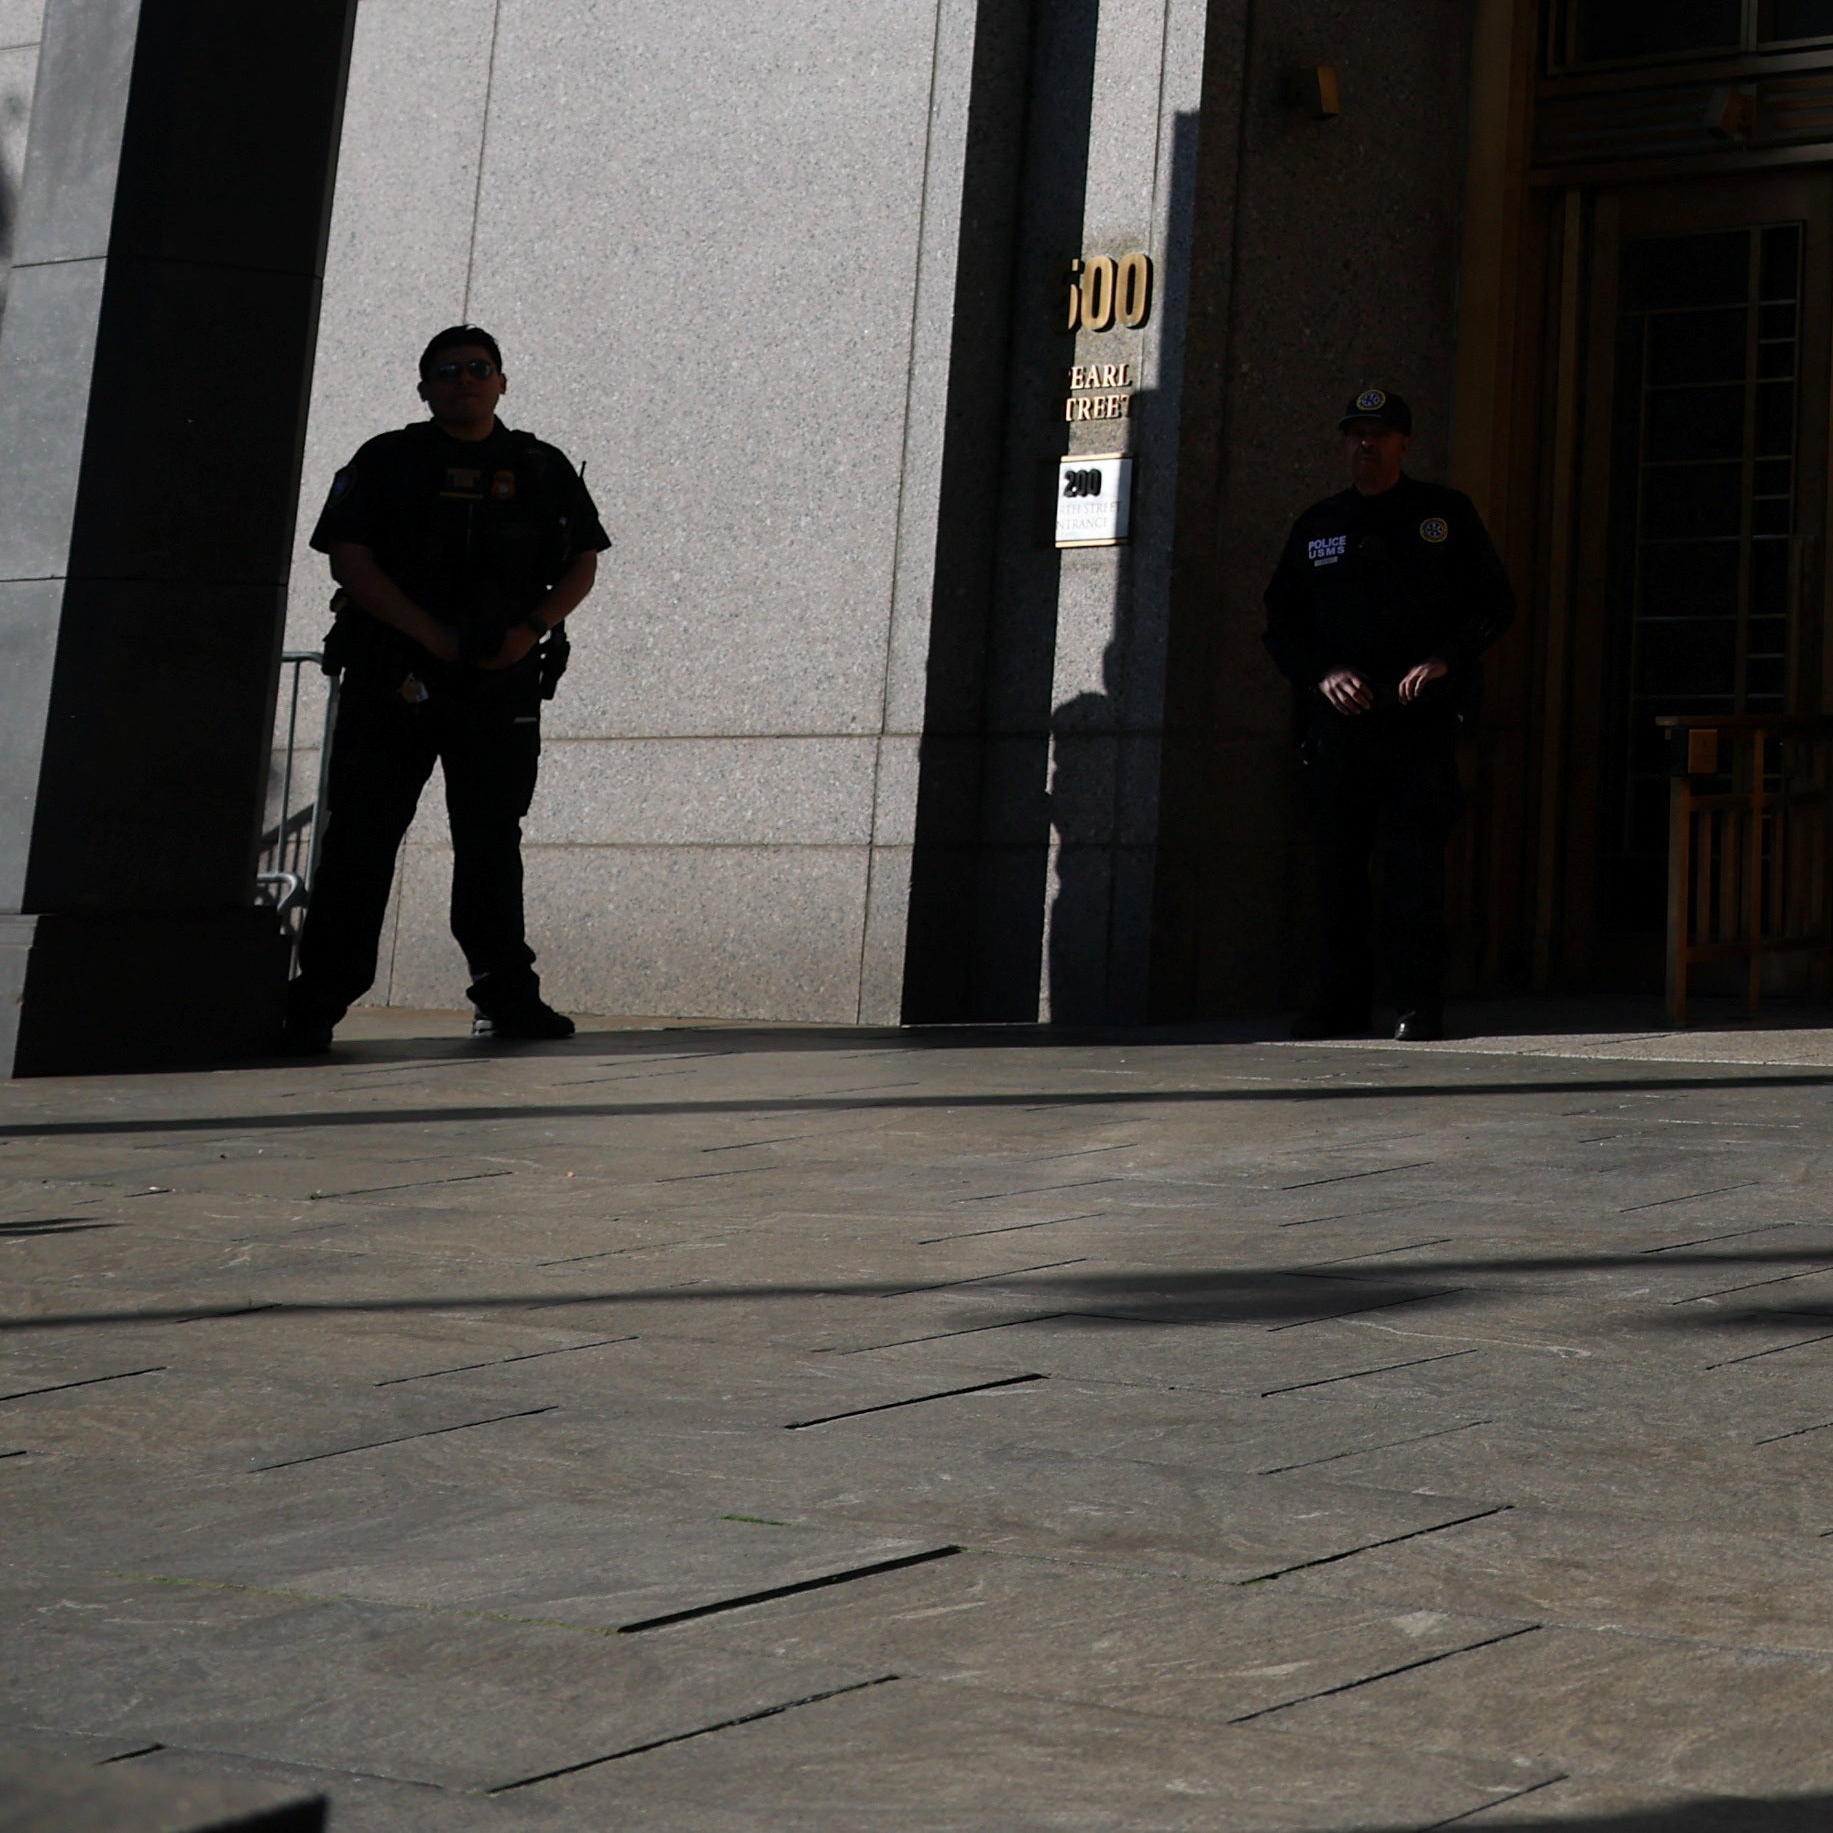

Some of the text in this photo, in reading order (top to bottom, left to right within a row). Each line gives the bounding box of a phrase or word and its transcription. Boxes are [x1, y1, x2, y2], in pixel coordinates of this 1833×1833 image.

[1068, 363, 1134, 391] EARL
[1065, 393, 1132, 422] TREET
[1063, 468, 1102, 498] 200
[1057, 517, 1109, 529] NTRANCE
[1308, 535, 1347, 551] POLICE
[1308, 546, 1345, 559] USMS
